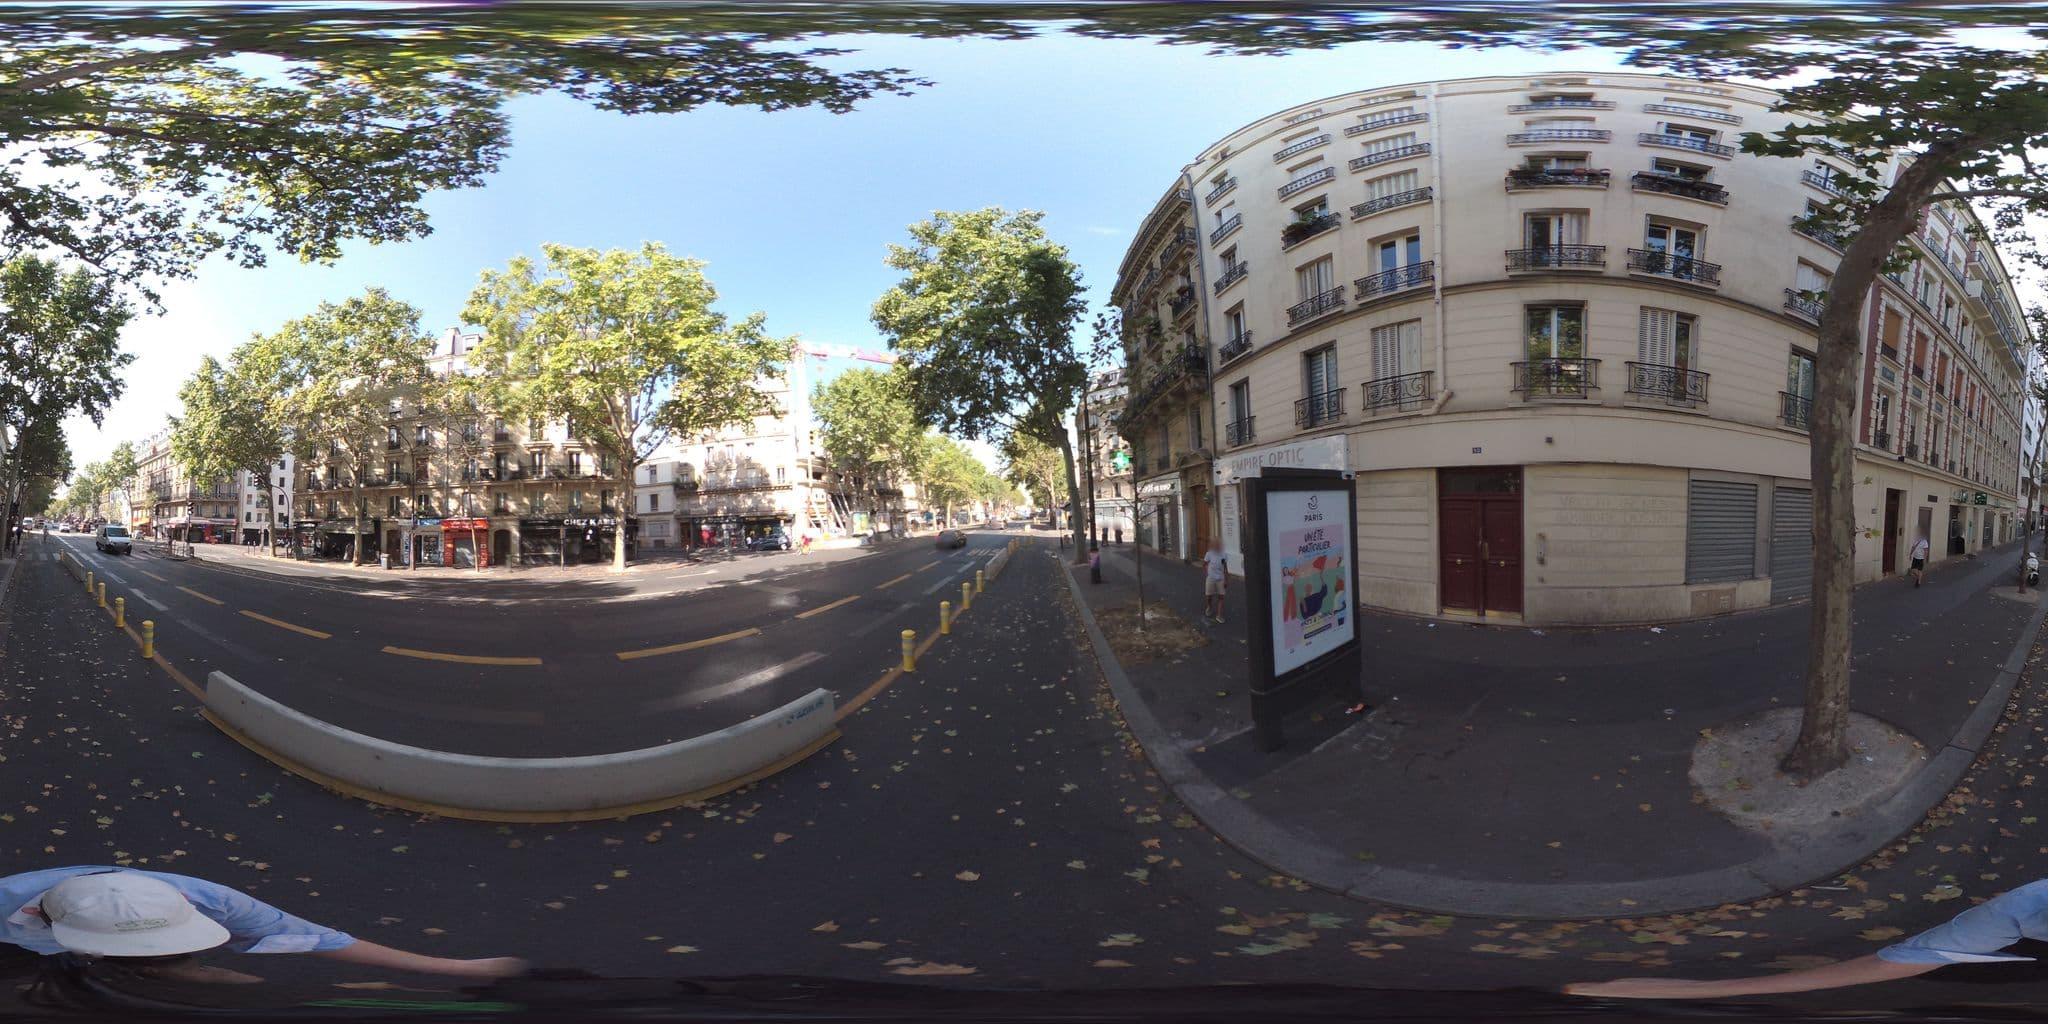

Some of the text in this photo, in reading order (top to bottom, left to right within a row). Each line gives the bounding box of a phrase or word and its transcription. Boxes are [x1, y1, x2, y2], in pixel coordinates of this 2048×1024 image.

[1231, 448, 1304, 472] EMPIRE OPTIC
[563, 518, 587, 526] CHEZ
[1304, 513, 1323, 522] PARIS
